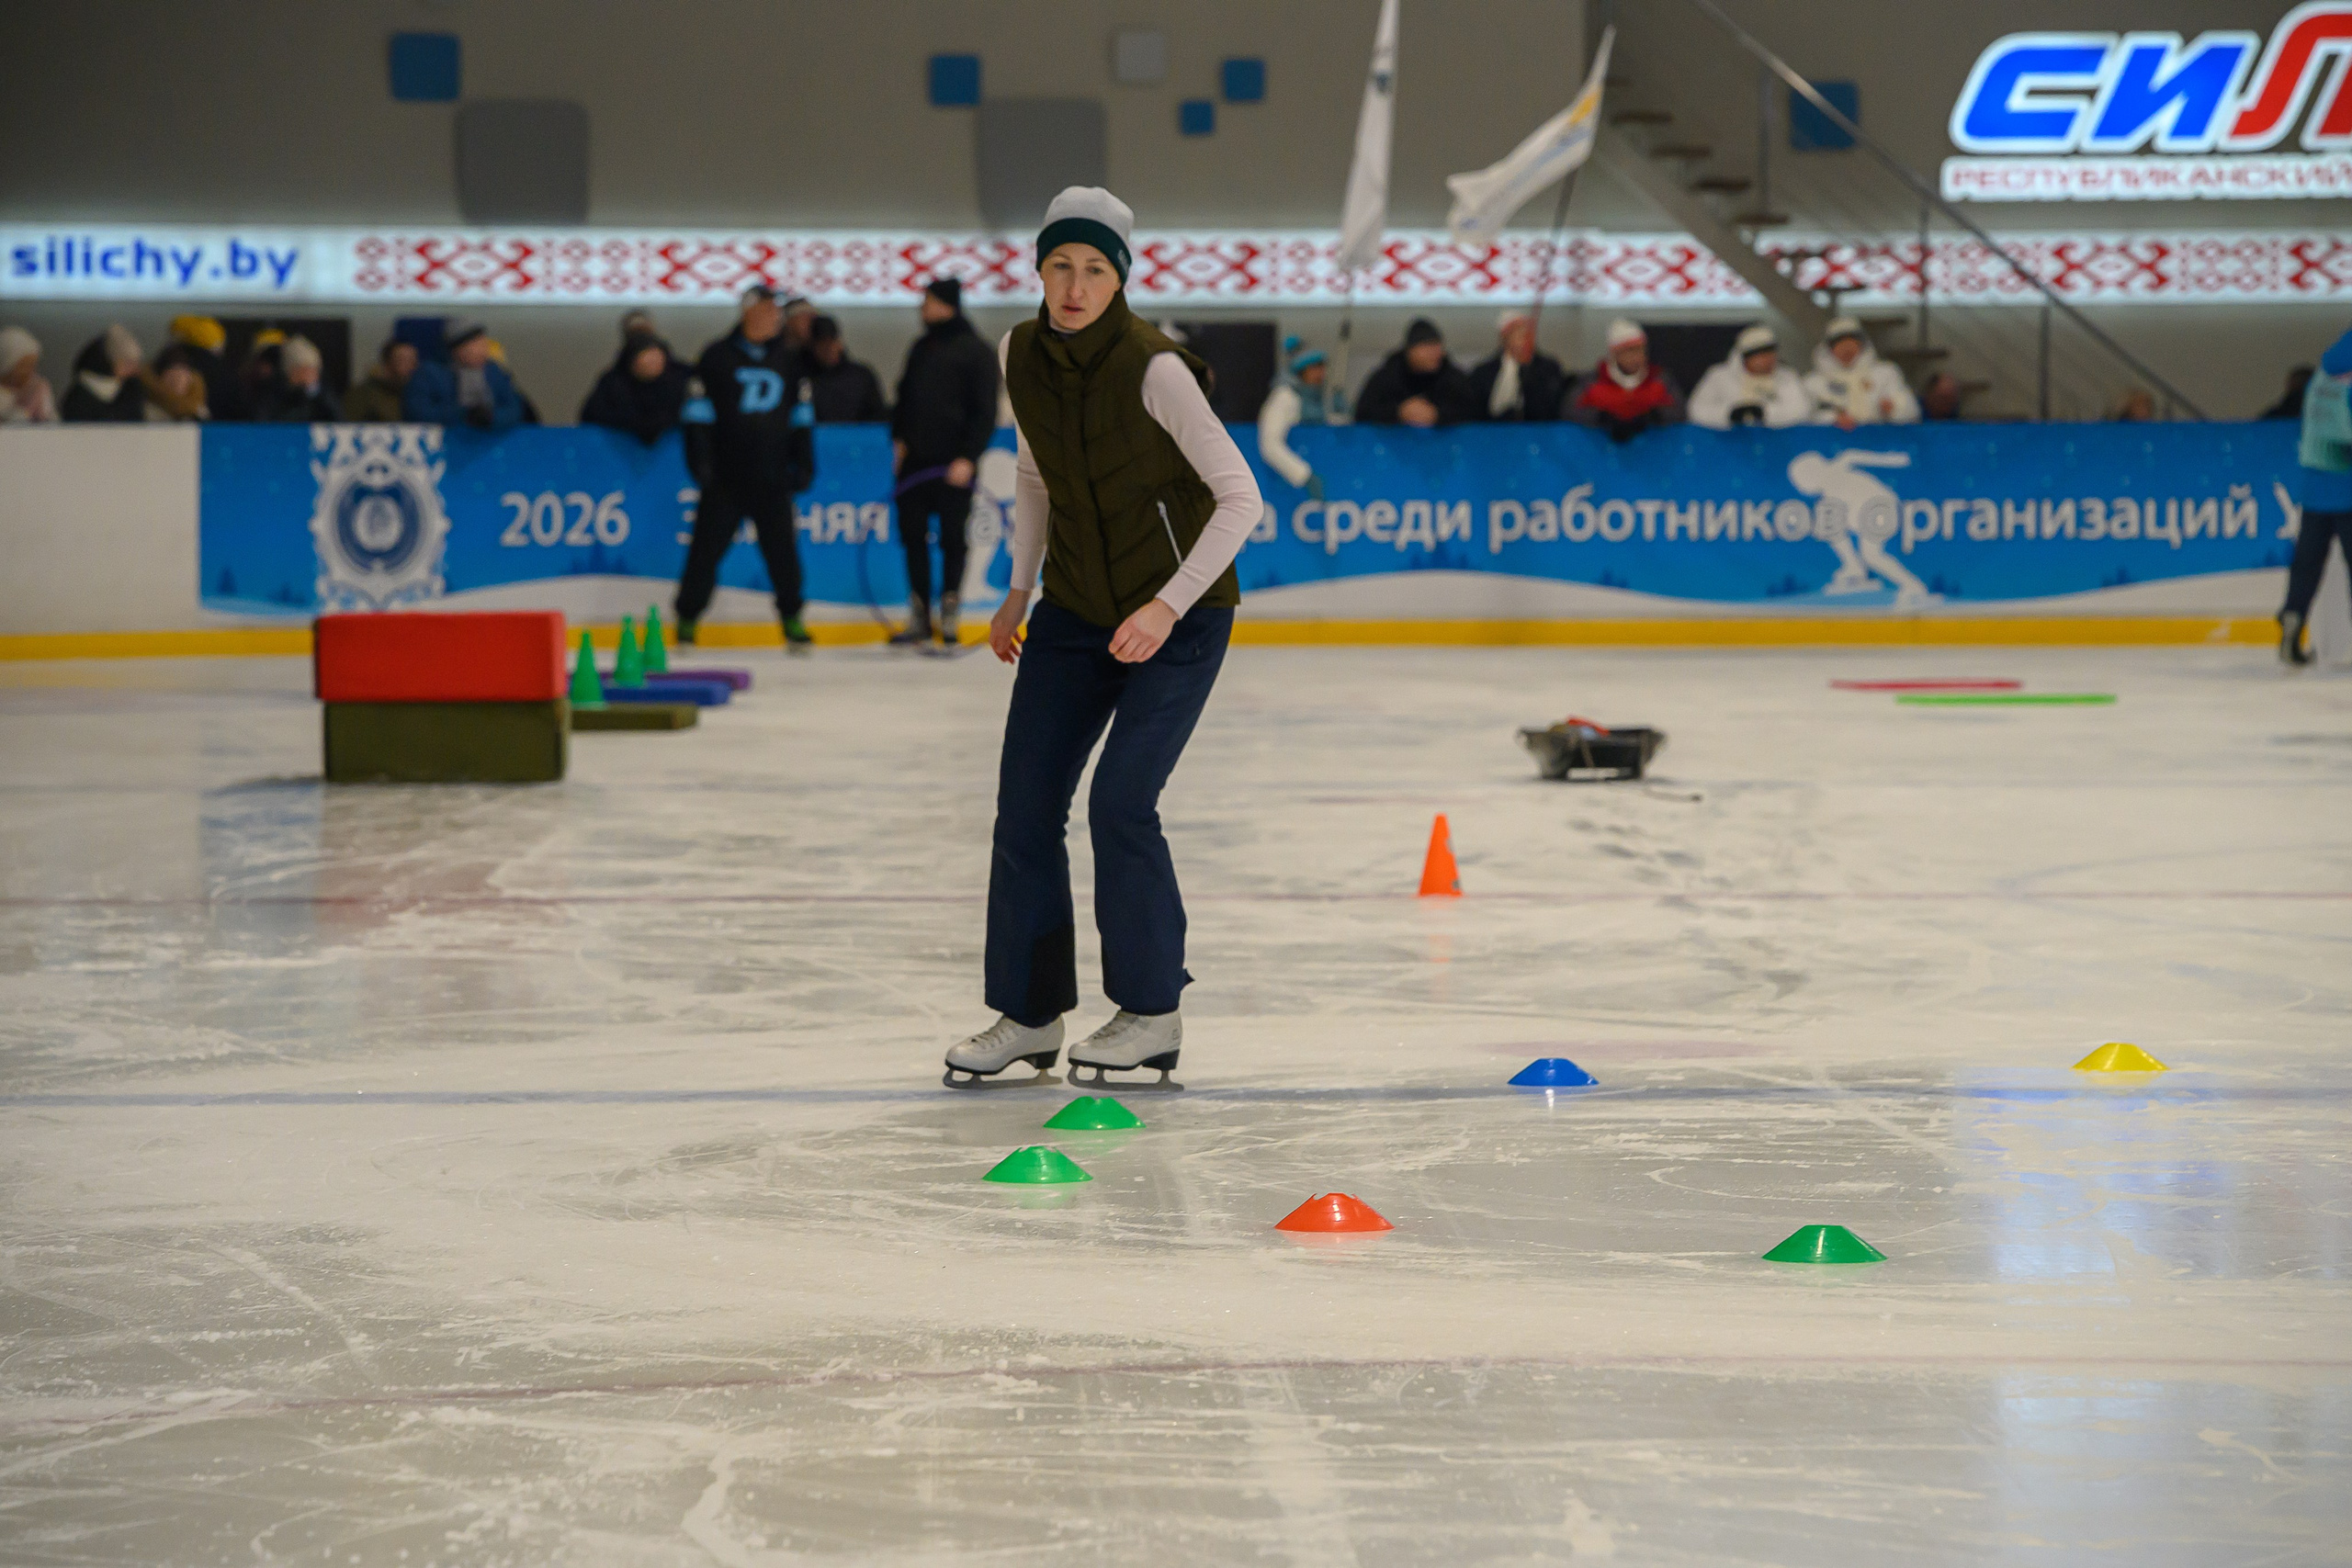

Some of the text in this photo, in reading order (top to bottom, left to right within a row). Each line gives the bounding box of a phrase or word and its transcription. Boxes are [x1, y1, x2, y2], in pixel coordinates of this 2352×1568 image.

[11, 236, 300, 289] silichy.by
[501, 490, 631, 547] 2026
[1291, 499, 1473, 555] среди
[1487, 482, 1848, 554] работников
[1859, 482, 2259, 554] организаций
